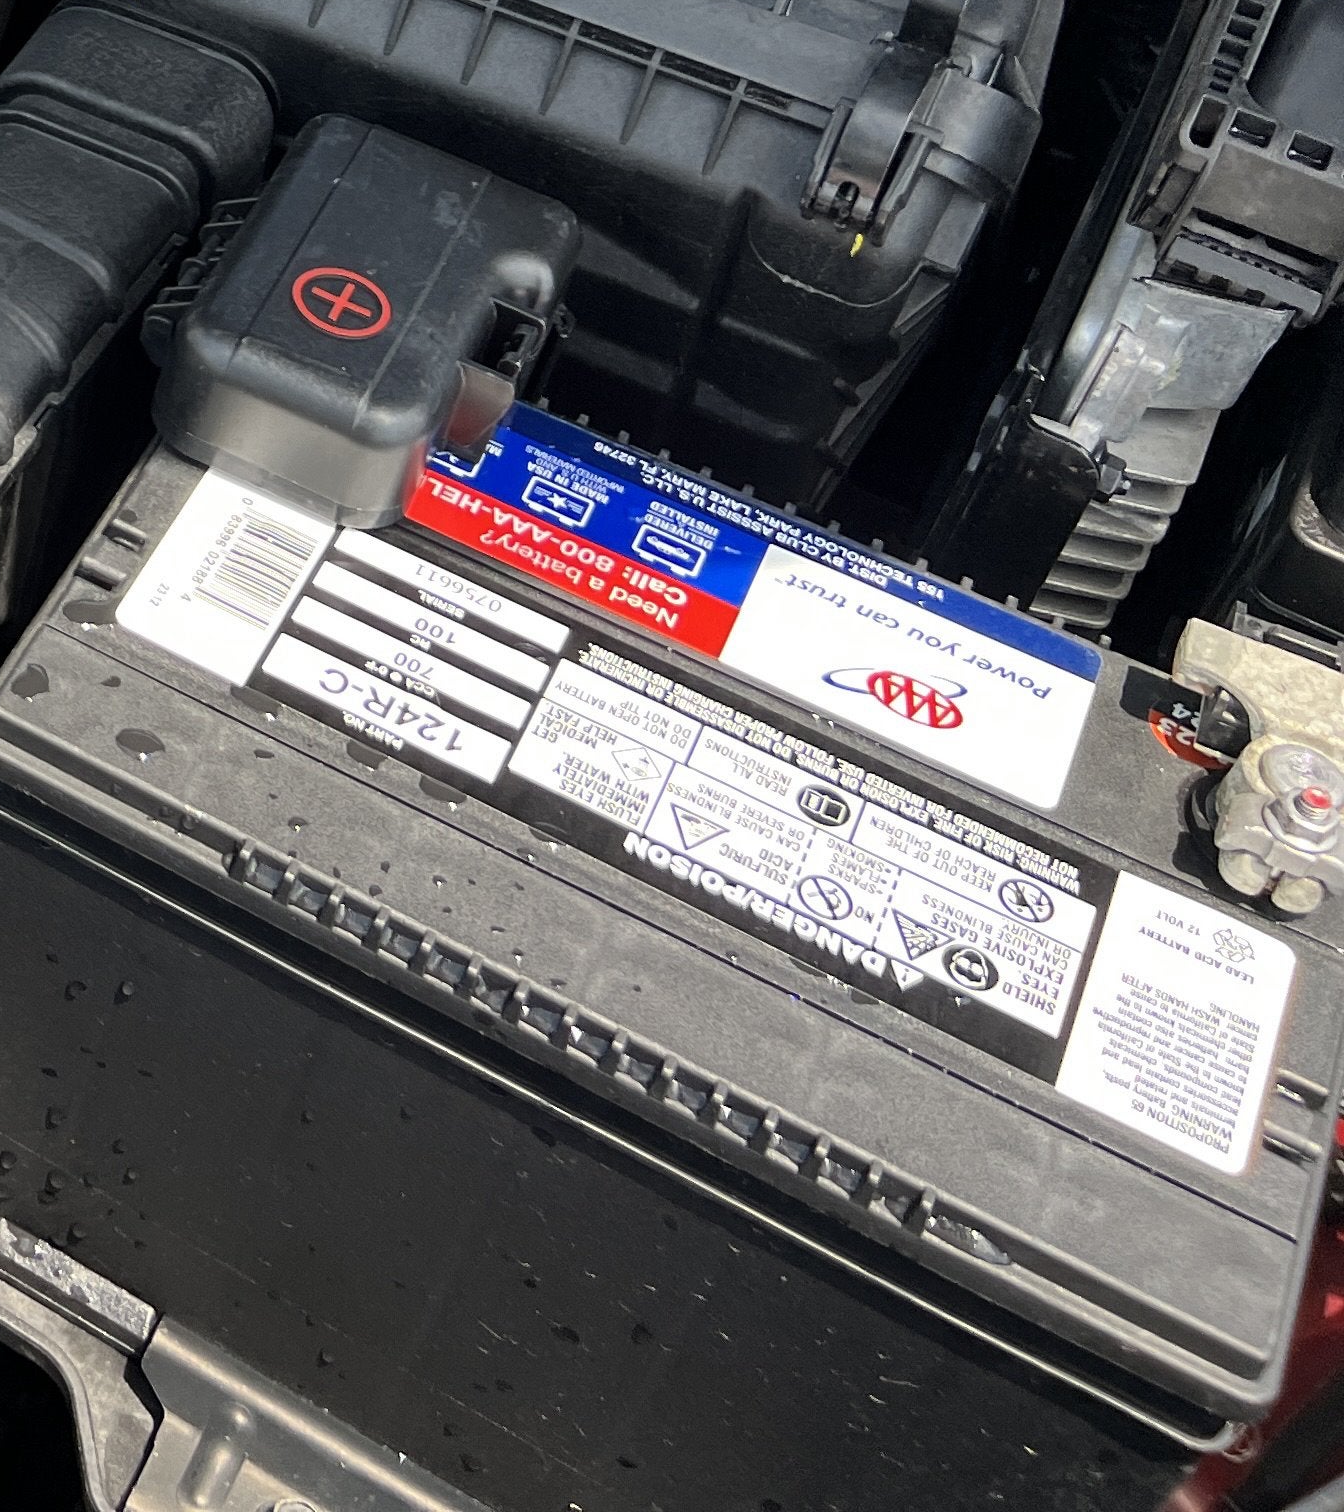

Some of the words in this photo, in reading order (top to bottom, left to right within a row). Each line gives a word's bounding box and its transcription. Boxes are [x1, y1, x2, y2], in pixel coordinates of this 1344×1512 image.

[592, 439, 638, 466] 32746
[636, 458, 654, 473] FL
[524, 460, 553, 479] USA
[552, 472, 570, 487] IN
[569, 480, 610, 505] MADE
[708, 489, 752, 515] LAKE
[418, 474, 616, 574] 800-AAA-HEL
[642, 511, 714, 550] DELIVERED
[648, 499, 720, 537] INSTALLED
[477, 523, 585, 585] battery?
[770, 530, 821, 558] CLUB
[799, 530, 917, 589] TECHNOLOGY
[818, 550, 847, 569] BY
[412, 561, 503, 614] 0756611
[586, 574, 605, 592] a
[619, 564, 690, 608] Call:
[913, 579, 947, 602] 155
[413, 587, 467, 620] SERIAL
[607, 584, 680, 629] Need
[412, 615, 459, 646] 100
[854, 603, 901, 633] can
[407, 632, 432, 651] RC
[906, 623, 961, 659] you
[391, 650, 436, 681] 700
[960, 650, 1052, 701] Power
[554, 679, 607, 710] BATTERY
[643, 681, 665, 700] OR
[670, 681, 734, 719] CHARGING
[867, 670, 963, 729] AAA
[314, 664, 470, 756] 124R-C
[607, 703, 640, 726] OPEN
[619, 697, 640, 713] TIP
[663, 691, 747, 738] DISASSEMBLE
[536, 712, 598, 749] MEDICAL
[641, 720, 667, 739] NOT
[644, 709, 670, 728] NOT
[672, 722, 692, 738] DO
[732, 710, 784, 742] PROPER
[363, 722, 405, 750] PART
[530, 722, 559, 744] GET
[582, 721, 618, 745] HELP
[668, 733, 688, 749] DO
[744, 729, 772, 751] NOT
[703, 737, 793, 786] INSTRUCTIONS
[770, 741, 792, 760] DO
[781, 733, 836, 766] FOLLOW
[730, 762, 753, 780] ALL
[837, 772, 860, 792] OR
[551, 761, 647, 814] IMMEDIATELY
[557, 778, 594, 803] EYES
[614, 777, 652, 803] WITH
[695, 782, 738, 808] BURNS
[754, 774, 788, 796] READ
[862, 770, 927, 809] INVERTED
[595, 796, 641, 826] FLUSH
[665, 781, 732, 819] BLINDNESS
[857, 781, 930, 825] EXPLOSION
[922, 798, 953, 821] FOR
[733, 814, 773, 839] CAUSE
[740, 803, 786, 831] SEVERE
[775, 833, 801, 852] CAN
[786, 825, 805, 841] OR
[868, 815, 933, 852] CHILDREN
[885, 834, 910, 854] THE
[951, 811, 1051, 866] RECOMMENDED
[961, 829, 983, 849] OF
[716, 842, 790, 885] SULFURIC
[757, 847, 794, 871] ACID
[911, 847, 930, 863] OF
[934, 845, 952, 861] OF
[981, 838, 1014, 864] RISK
[932, 857, 958, 876] OUT
[953, 854, 997, 882] REACH
[1012, 853, 1082, 895] WARNING:
[1049, 856, 1079, 879] NOT
[959, 870, 993, 892] KEEP
[617, 829, 892, 977] DANGER/POISON
[852, 904, 875, 924] NO
[920, 893, 993, 934] BLINDNESS
[928, 911, 979, 943] GASES
[1155, 908, 1184, 928] VOLT
[1187, 922, 1201, 936] 12
[995, 928, 1039, 956] CAUSE
[1052, 943, 1072, 959] OR
[1137, 924, 1190, 955] BATTERY
[980, 936, 1065, 984] EXPLOSIVE
[1040, 950, 1068, 970] CAN
[1193, 950, 1221, 969] ACID
[1224, 964, 1254, 984] LEAD
[1000, 980, 1056, 1015] SHIELD
[1154, 987, 1189, 1011] HANDS
[1129, 1097, 1145, 1113] 65
[1146, 1105, 1230, 1154] PROPOSITION
[1170, 1103, 1233, 1142] WARNING
